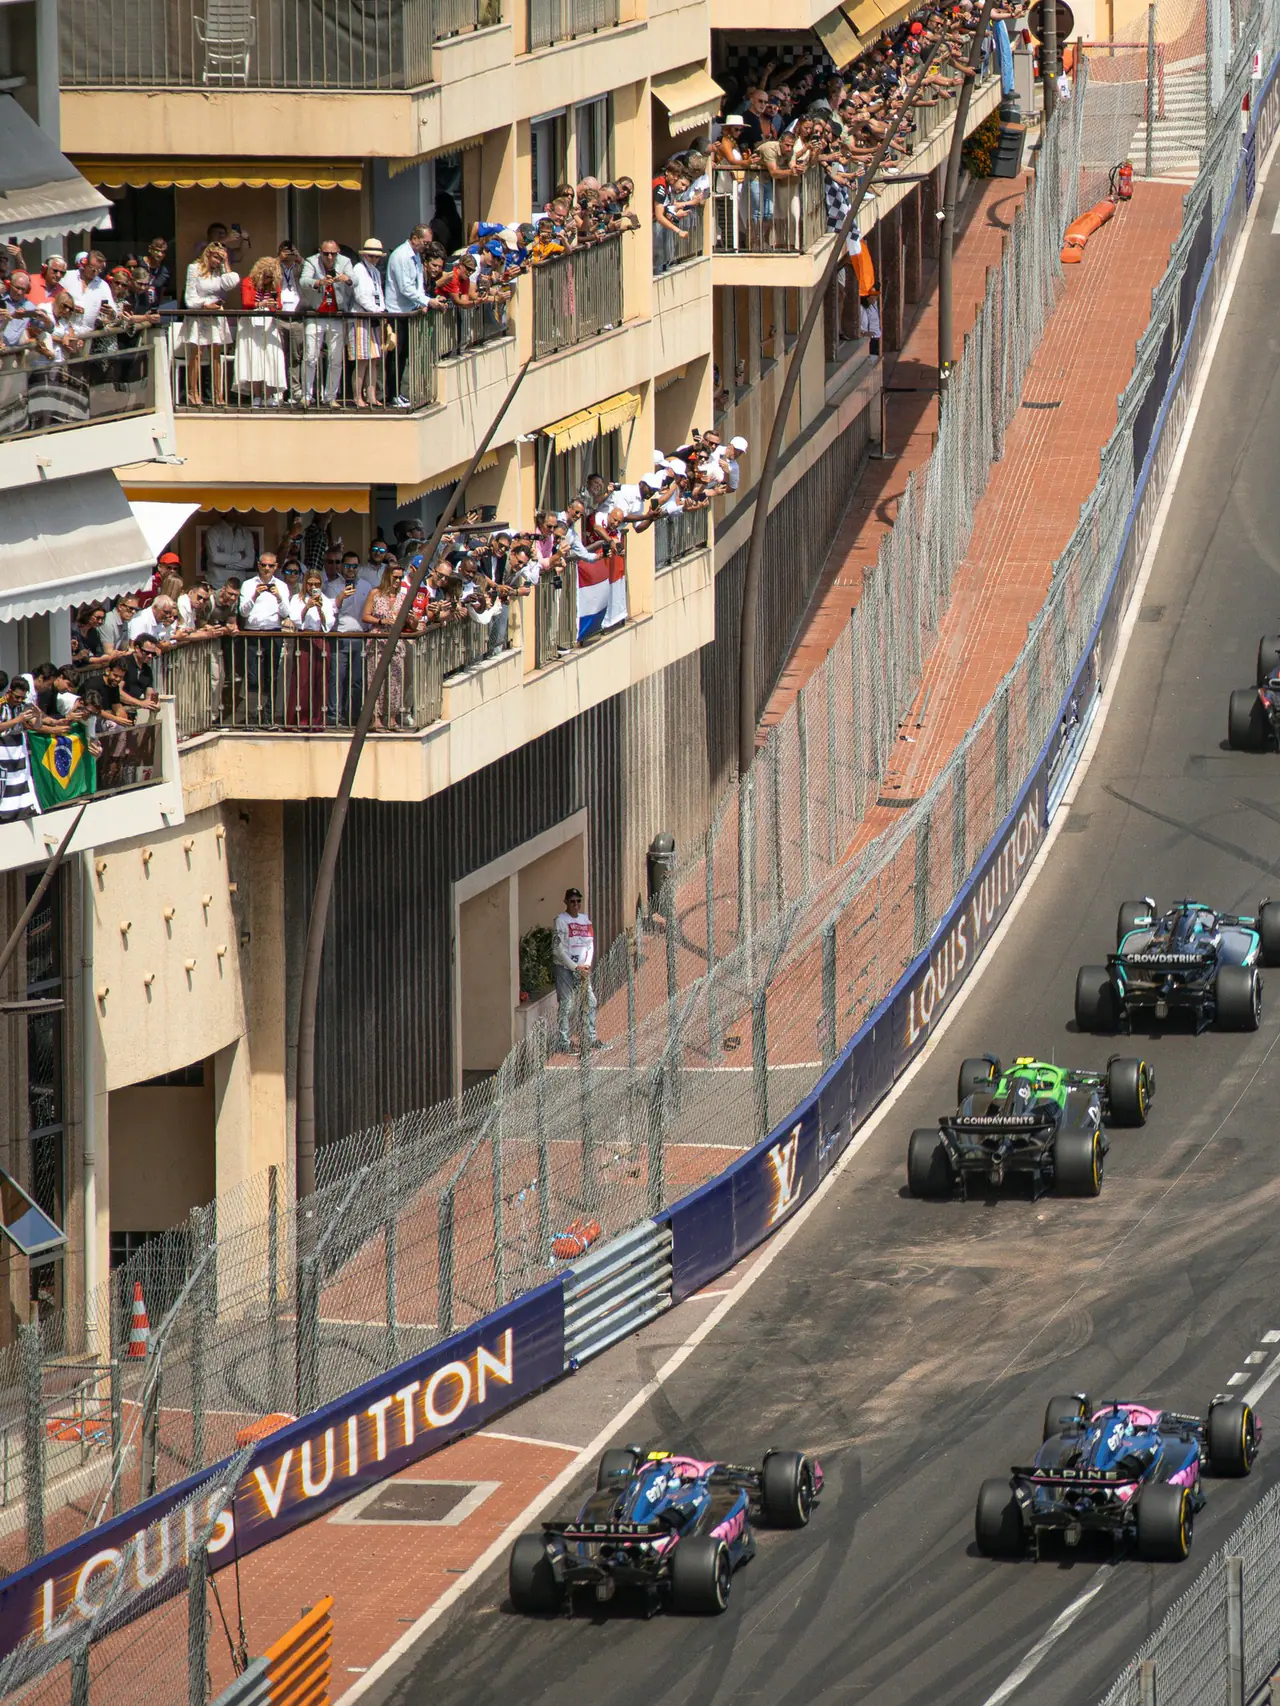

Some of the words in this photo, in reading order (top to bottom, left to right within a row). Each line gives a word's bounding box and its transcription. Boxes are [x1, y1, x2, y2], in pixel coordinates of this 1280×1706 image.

[906, 919, 968, 1046] LOUIS
[971, 788, 1041, 947] VUITTON
[1127, 953, 1203, 964] CROWDSTRIKE
[963, 1116, 1035, 1126] COINPAYMENTS
[1033, 1470, 1119, 1480] ALPINE
[38, 1484, 236, 1644] LOUIS
[253, 1327, 515, 1520] VUITTON
[564, 1523, 650, 1534] ALPINE
